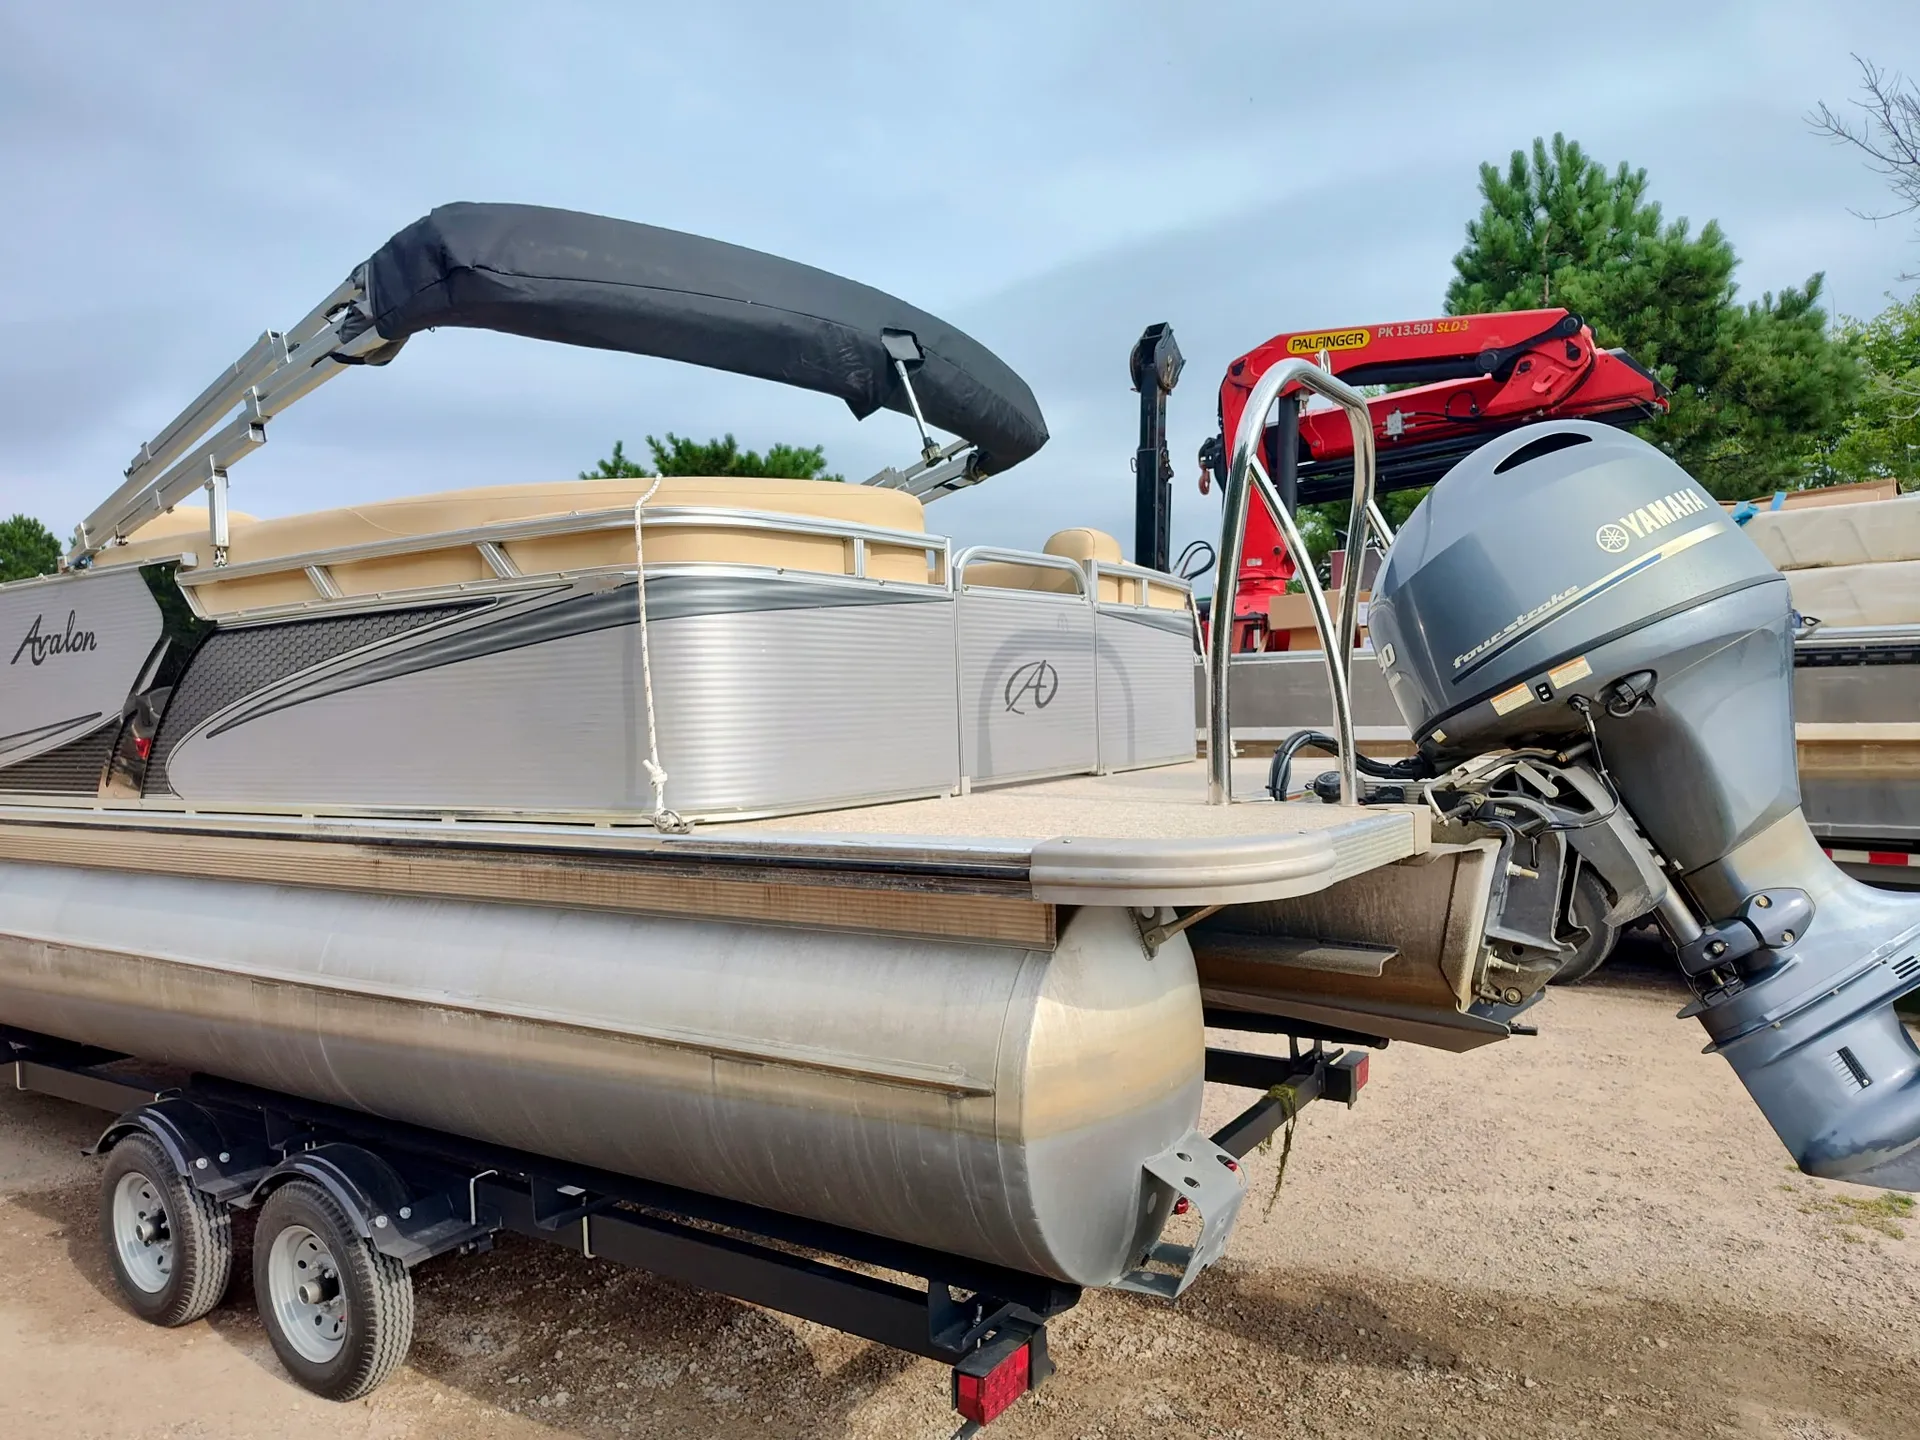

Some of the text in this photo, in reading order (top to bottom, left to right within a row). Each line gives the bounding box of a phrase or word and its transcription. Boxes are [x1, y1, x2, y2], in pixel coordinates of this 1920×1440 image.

[1292, 332, 1365, 351] PALFINGER
[1378, 326, 1394, 339] PK
[1397, 323, 1434, 337] 13.501
[1619, 488, 1709, 539] YAMAHA
[10, 609, 97, 666] Avalon
[1453, 585, 1580, 669] fourstroke
